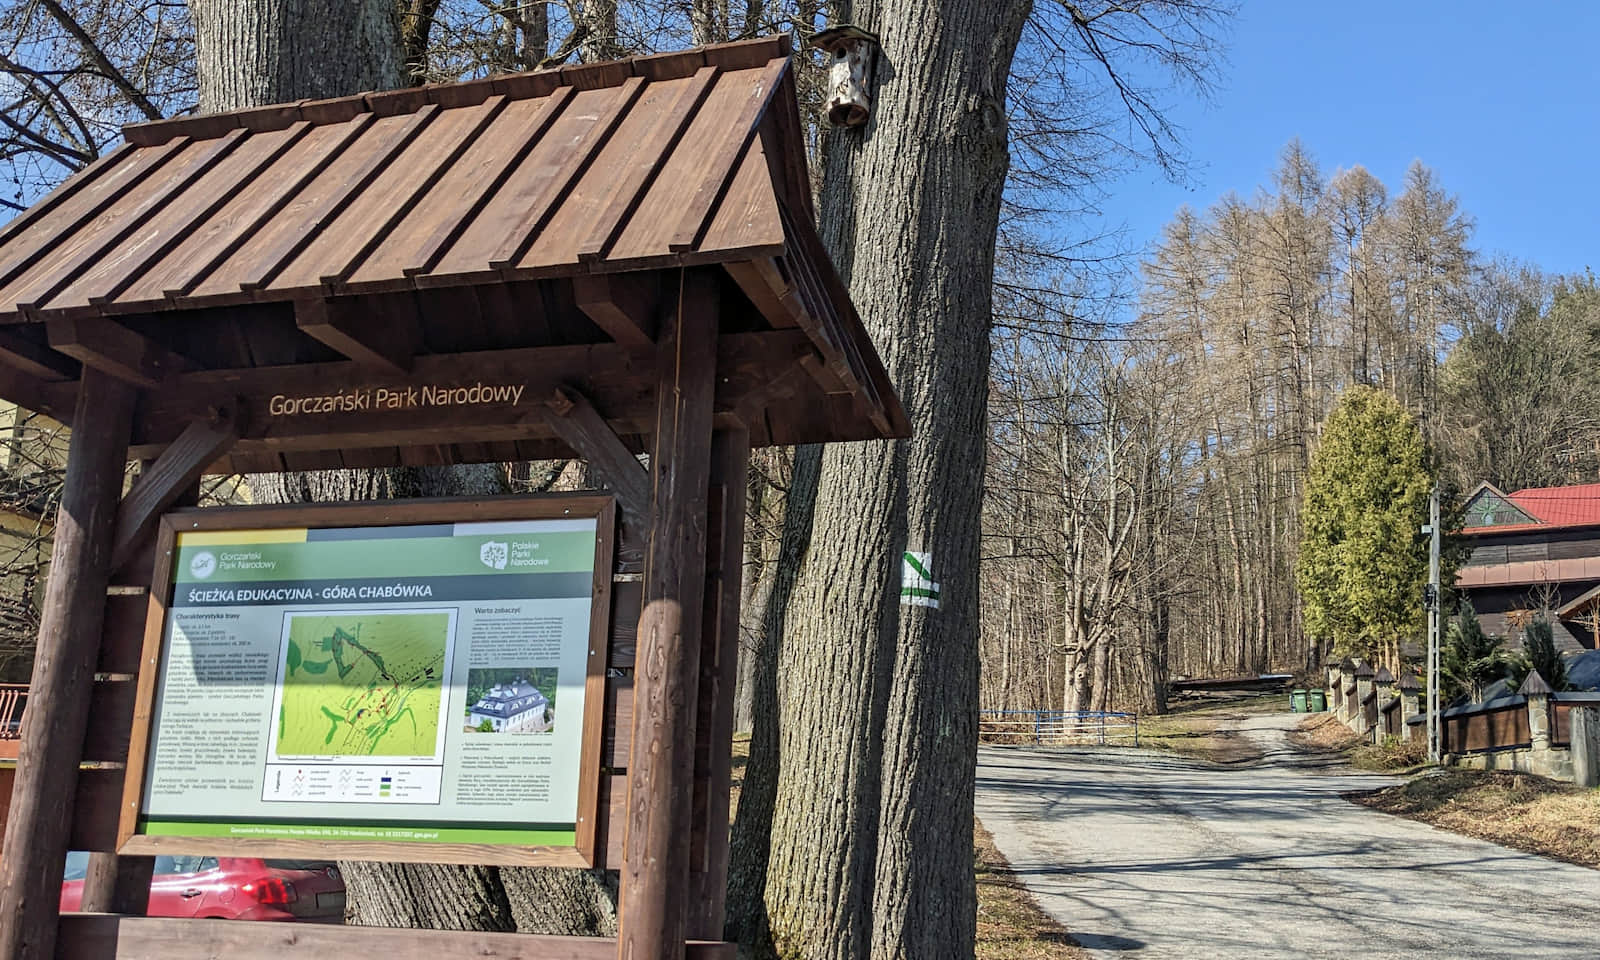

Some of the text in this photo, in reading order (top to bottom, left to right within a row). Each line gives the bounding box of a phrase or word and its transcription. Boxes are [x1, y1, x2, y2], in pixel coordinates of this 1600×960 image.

[269, 382, 525, 416] Gorczański Park Narodowy
[219, 552, 262, 561] Gorczański
[219, 560, 277, 570] Park Narodowy
[188, 587, 235, 602] ŚCIEŻKA
[236, 587, 313, 601] EDUKACYJNA
[322, 584, 357, 599] GÓRA
[358, 583, 433, 598] CHABÓWKA
